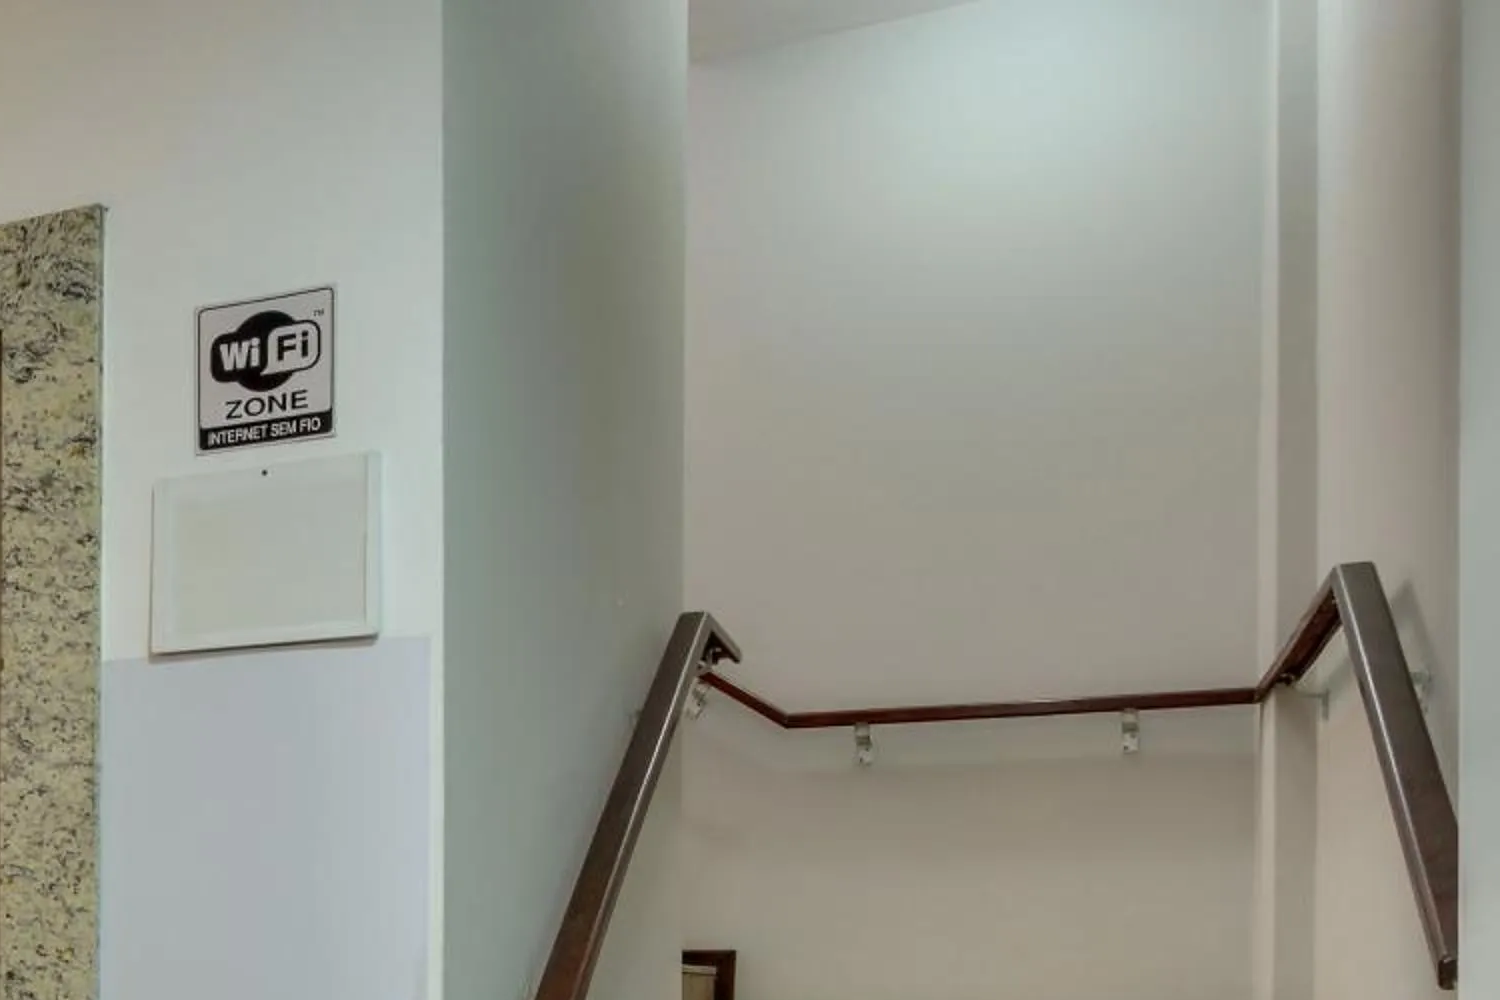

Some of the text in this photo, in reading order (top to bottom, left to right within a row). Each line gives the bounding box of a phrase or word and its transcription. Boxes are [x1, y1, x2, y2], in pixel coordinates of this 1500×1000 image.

[225, 389, 308, 420] ZONE
[207, 416, 321, 446] INTERNET SEM FIO
